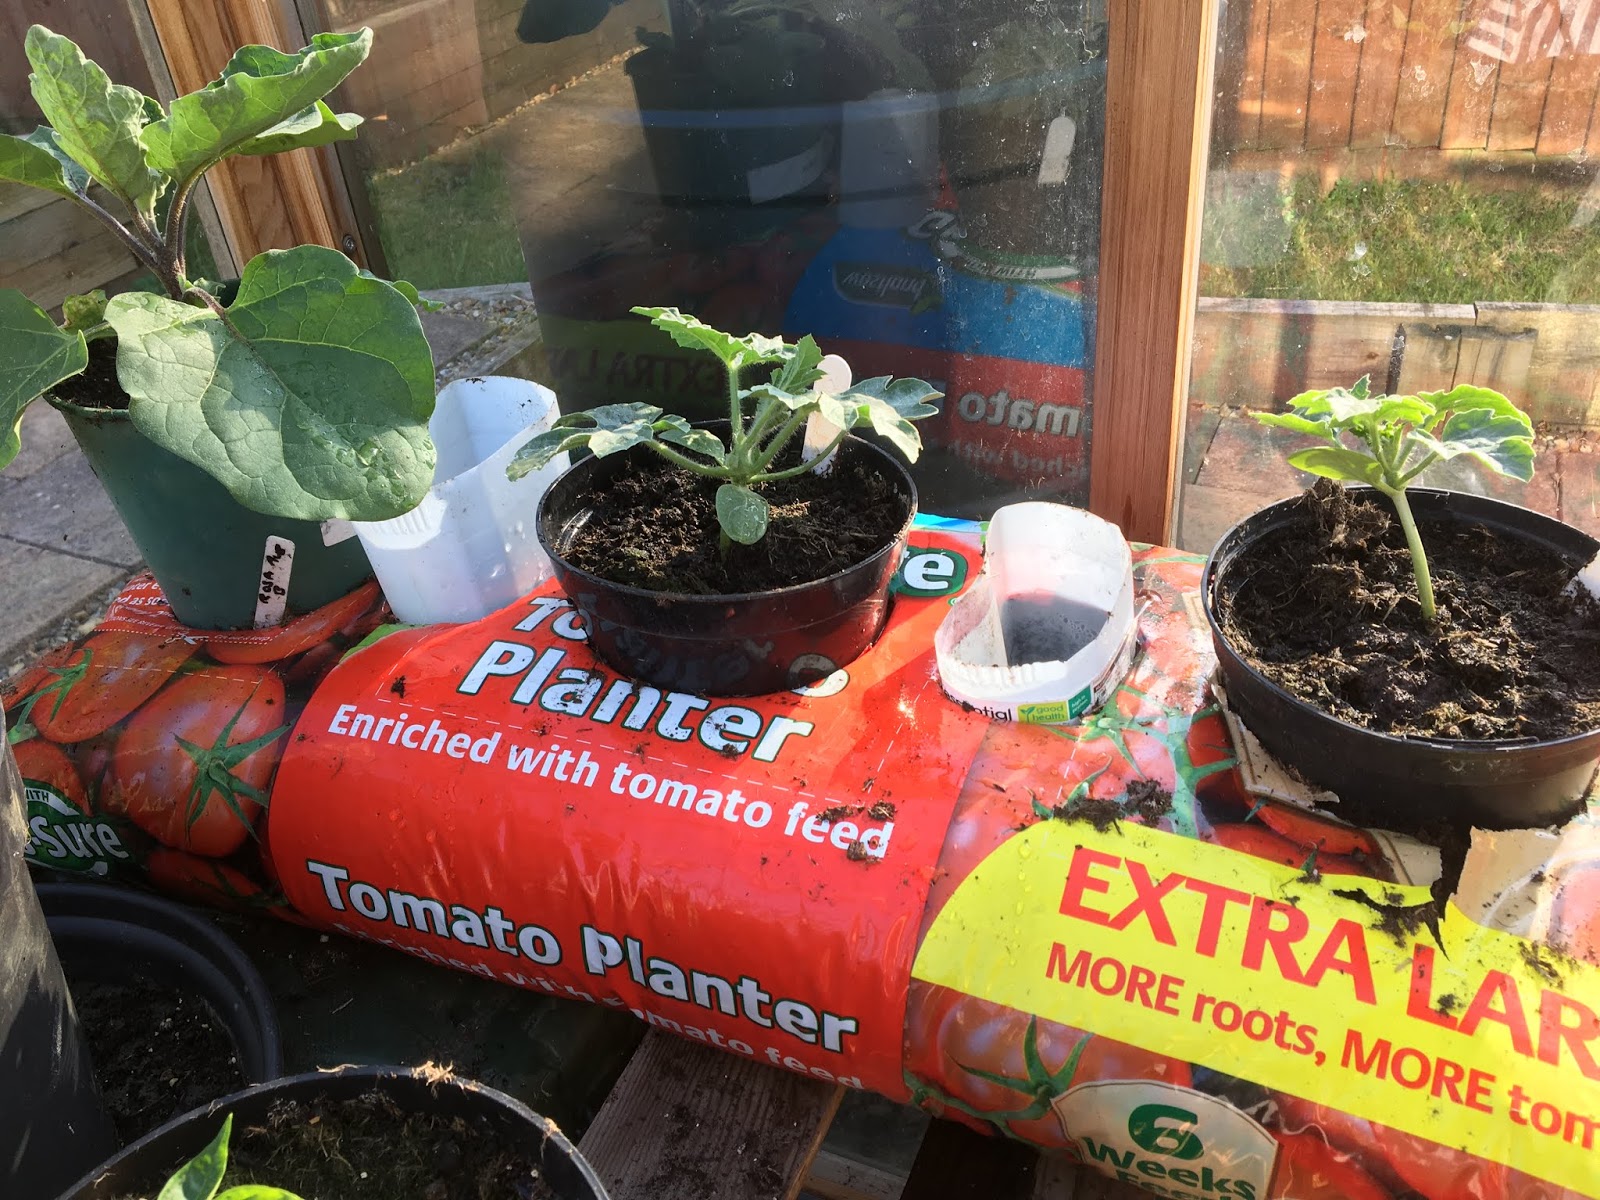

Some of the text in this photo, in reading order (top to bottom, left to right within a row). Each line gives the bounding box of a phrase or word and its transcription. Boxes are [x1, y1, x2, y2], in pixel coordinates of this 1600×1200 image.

[457, 639, 815, 762] Planter
[1032, 712, 1066, 722] health
[1036, 704, 1064, 716] good
[328, 703, 895, 860] Enriched with tomato feed
[24, 815, 130, 859] -Sure
[307, 859, 859, 1054] Tomato Planter
[1058, 845, 1377, 1006] EXTRA
[1045, 941, 1185, 1017] MORE
[1192, 992, 1327, 1067] roots,
[1340, 1028, 1497, 1115] MORE
[1081, 1136, 1256, 1200] Weeks
[1128, 1103, 1204, 1161] 6
